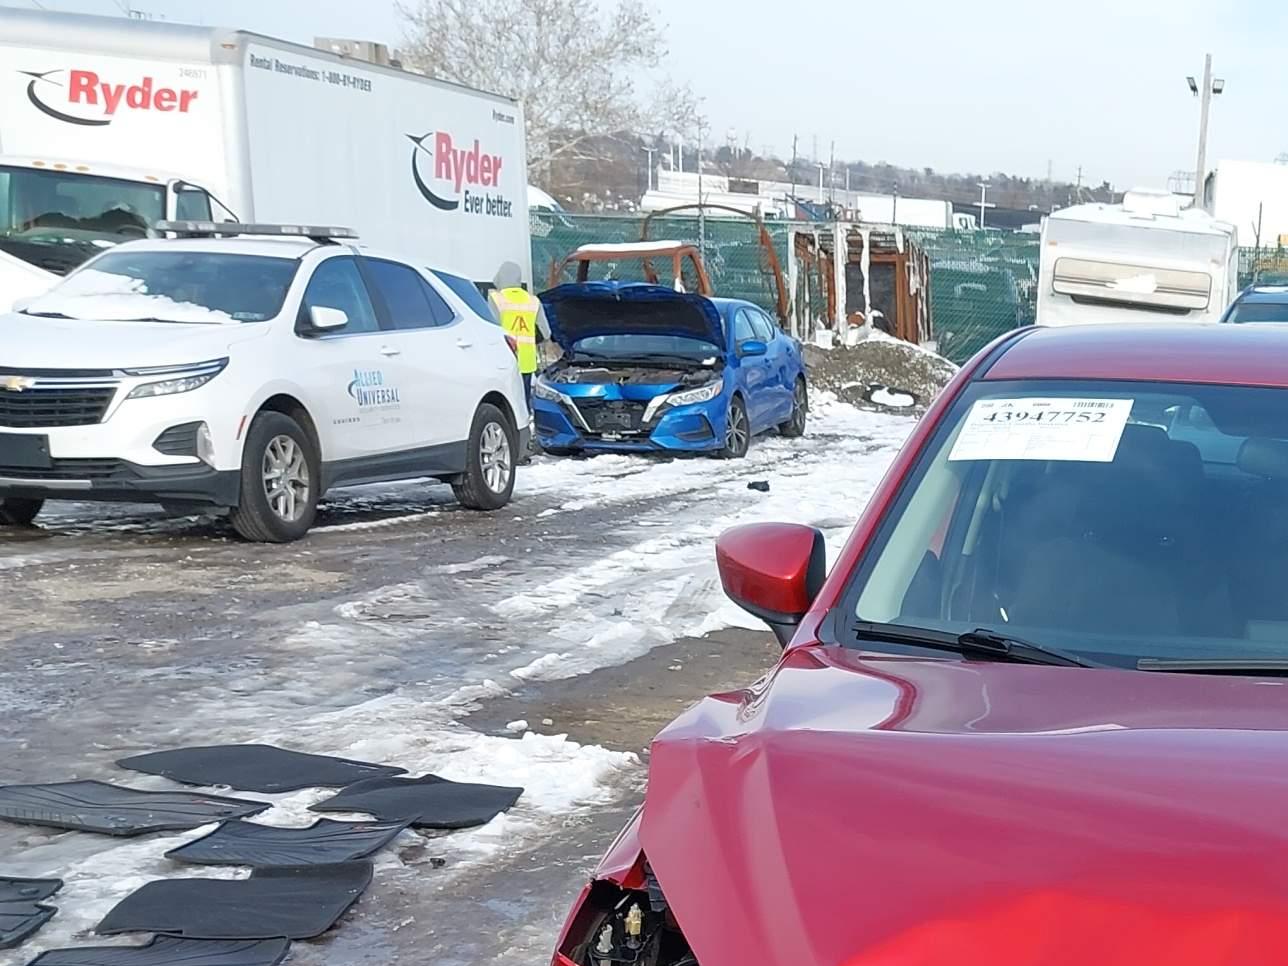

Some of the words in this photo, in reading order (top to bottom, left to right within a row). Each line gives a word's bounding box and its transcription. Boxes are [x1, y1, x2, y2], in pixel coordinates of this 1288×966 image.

[68, 69, 199, 115] Ryder
[434, 130, 502, 194] Ryder
[464, 189, 484, 214] Ever
[486, 193, 513, 217] better.
[356, 387, 401, 406] UNIVERSAL
[983, 410, 1107, 423] 43947752
